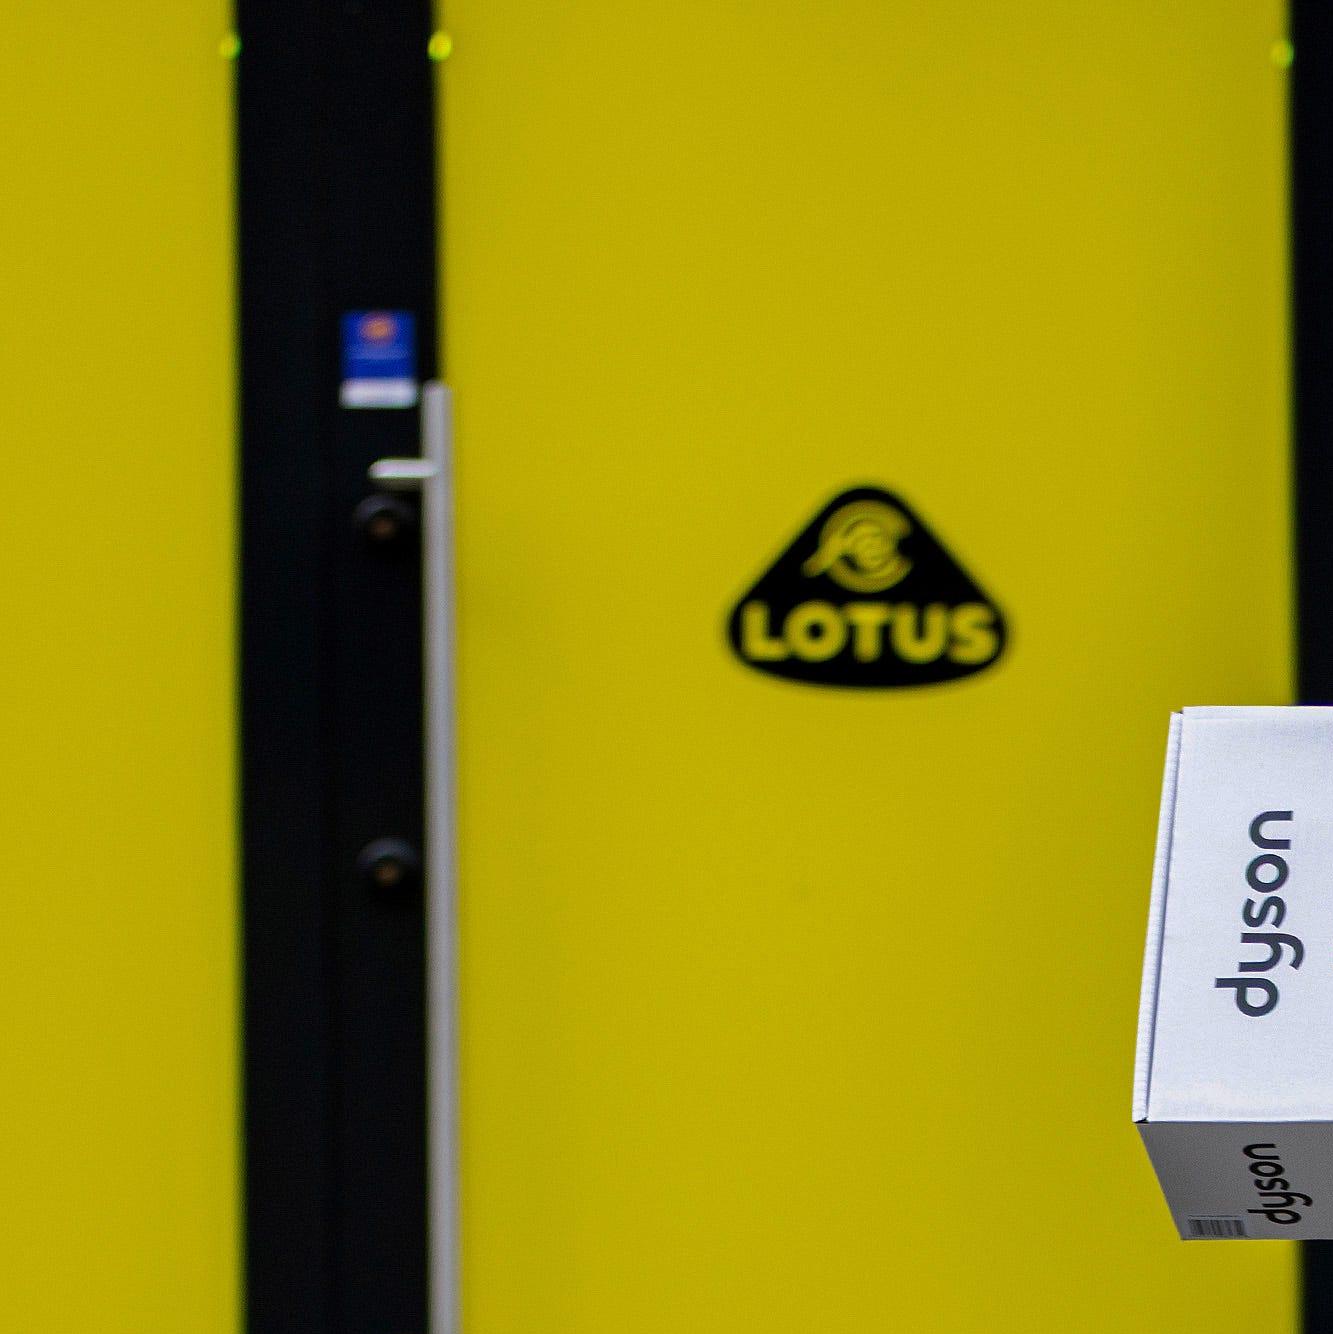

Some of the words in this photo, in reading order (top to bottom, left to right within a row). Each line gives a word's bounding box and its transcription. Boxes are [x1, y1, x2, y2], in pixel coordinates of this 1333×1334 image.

[741, 601, 998, 664] LOTUS
[1215, 810, 1305, 1018] dyson
[1243, 1143, 1313, 1225] dyson
